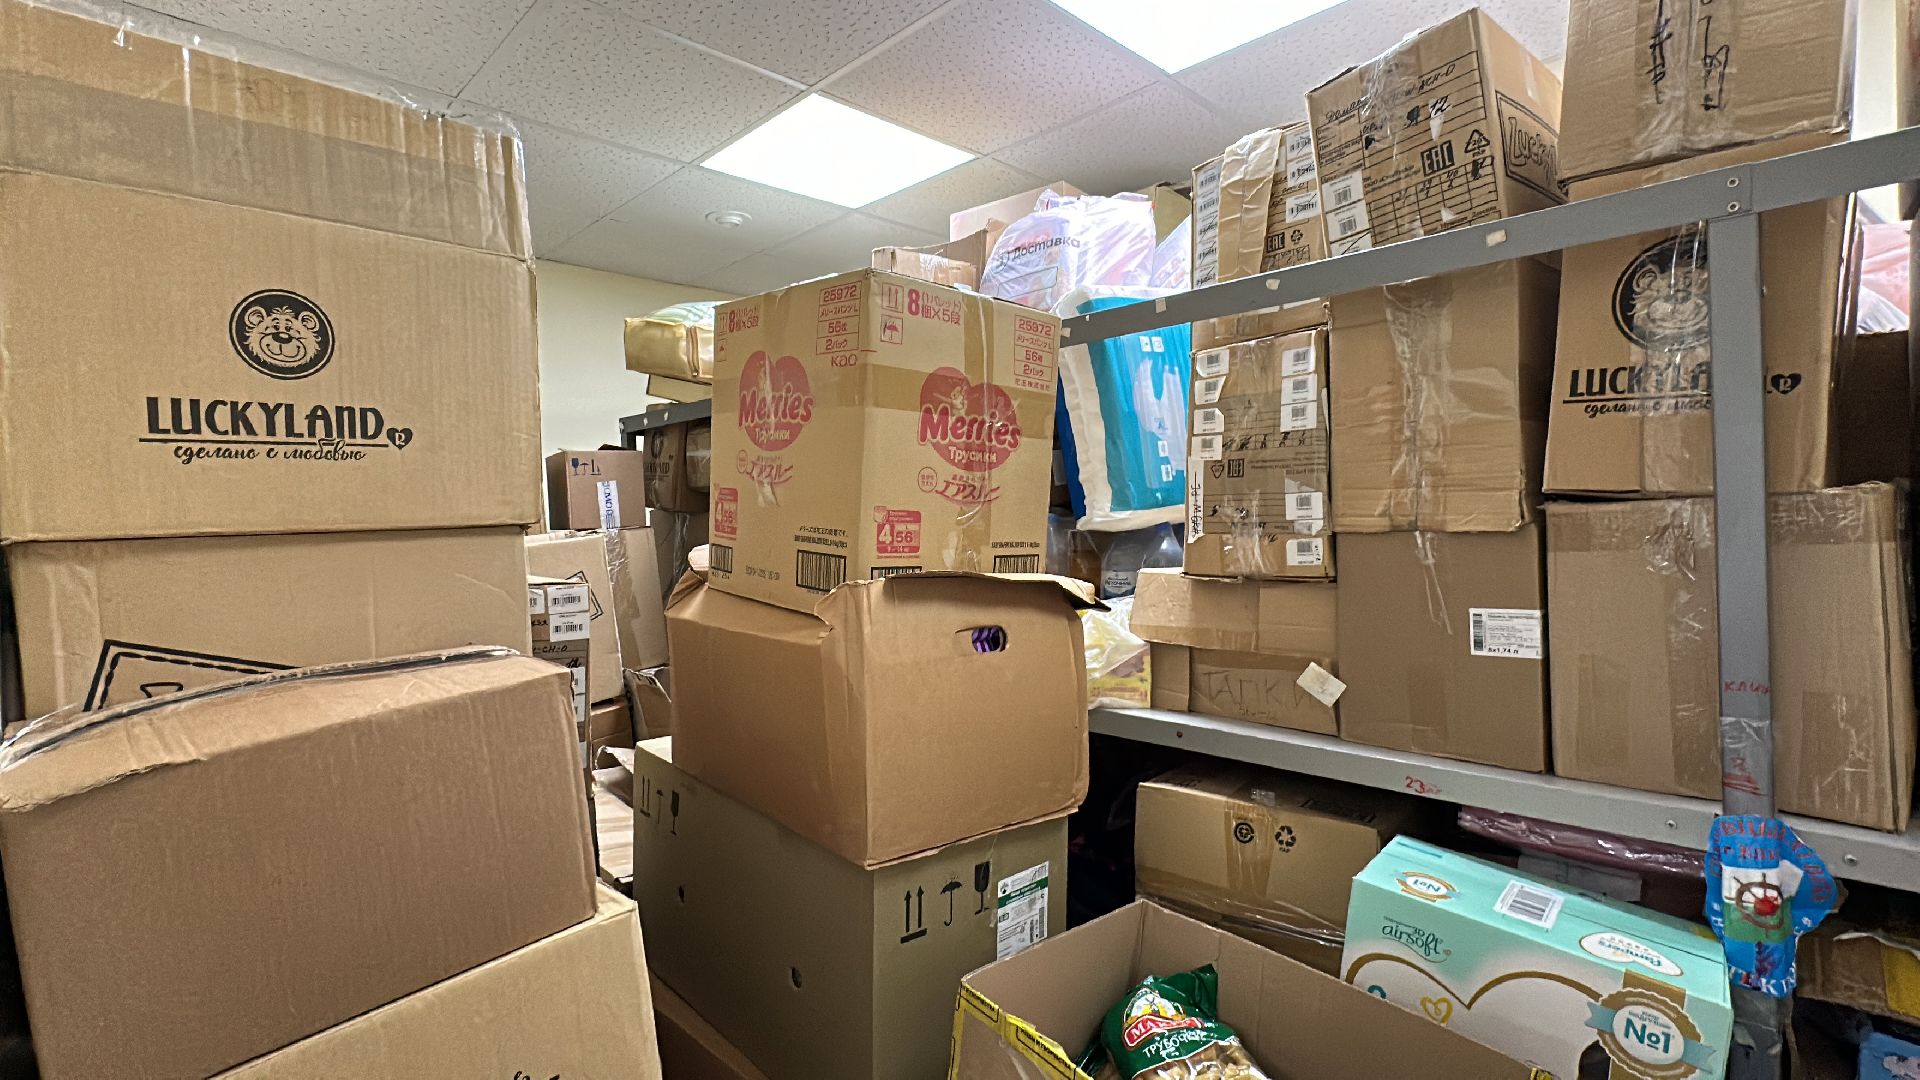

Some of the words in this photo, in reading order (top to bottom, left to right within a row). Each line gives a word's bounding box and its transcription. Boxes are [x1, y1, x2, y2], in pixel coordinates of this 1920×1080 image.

[823, 284, 857, 302] 25972
[907, 288, 920, 316] 8
[1017, 318, 1053, 336] 25972
[145, 396, 385, 440] LUCKYLAND
[738, 383, 815, 427] Merries
[918, 404, 1021, 450] Merries
[173, 444, 260, 465] сделано
[265, 446, 278, 459] с
[283, 438, 367, 461] любовью
[948, 445, 997, 463] Трусики
[878, 523, 892, 544] 4
[895, 531, 913, 543] 56
[1382, 924, 1440, 957] airsoft
